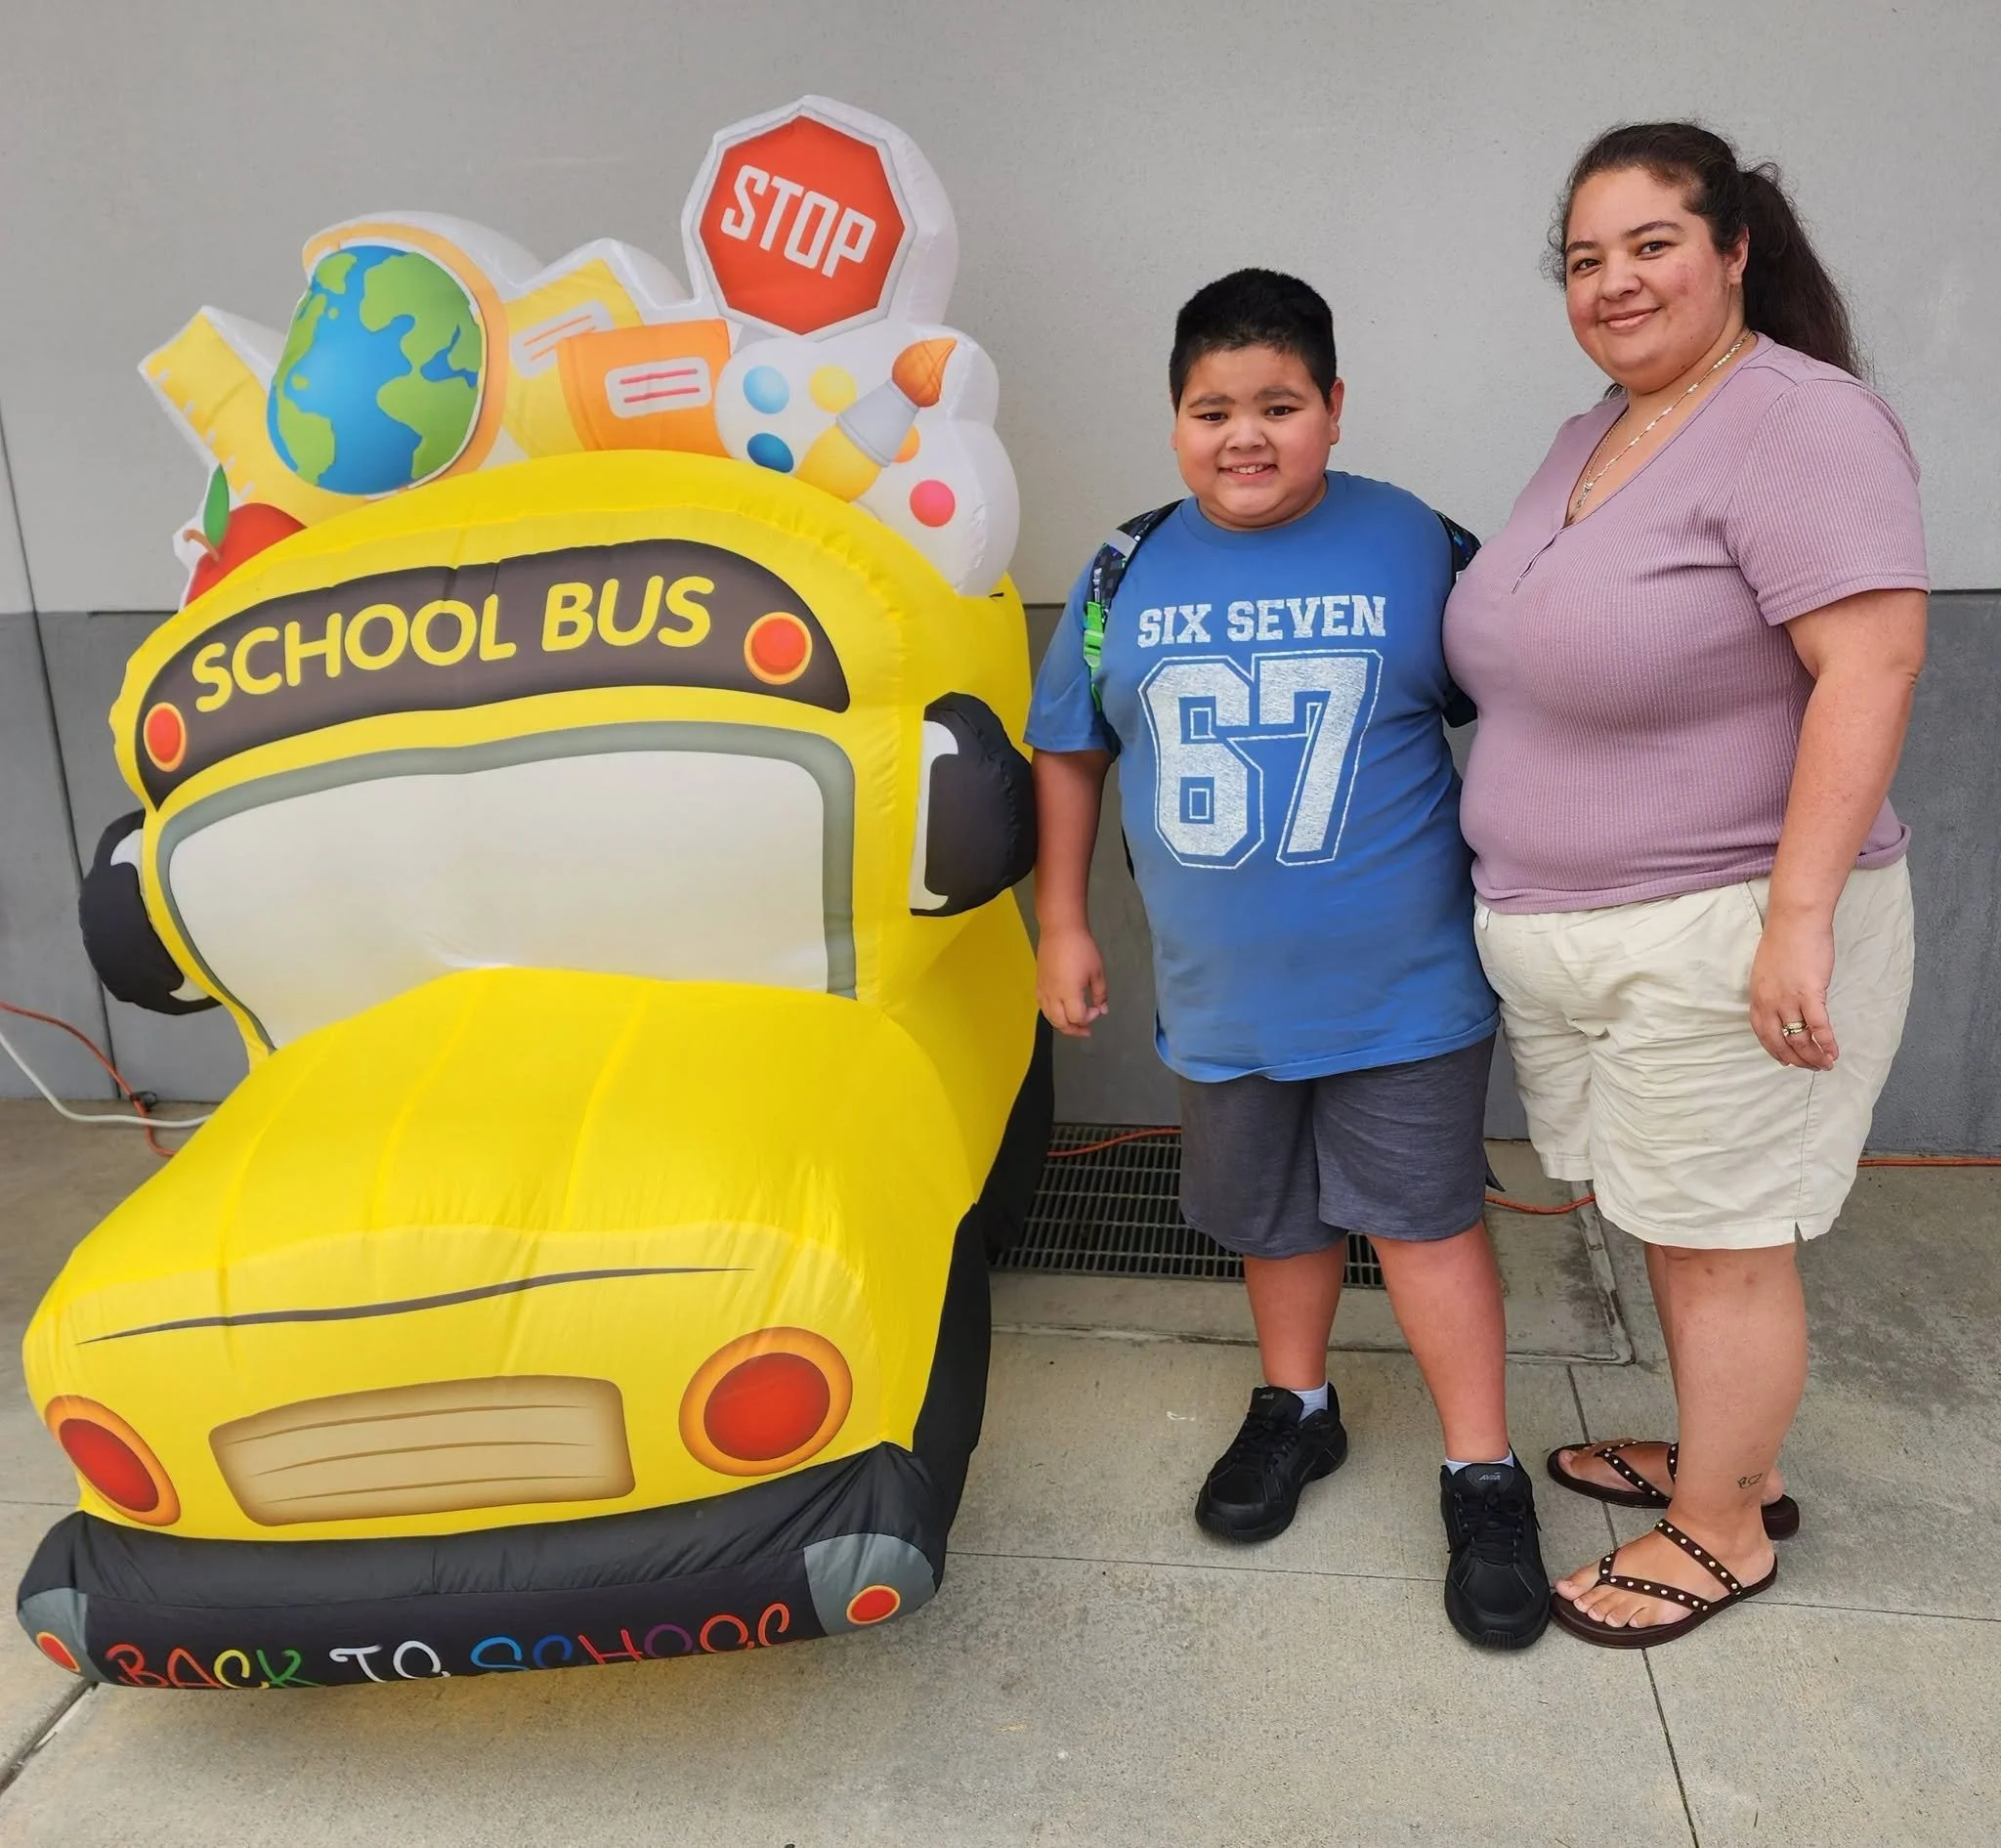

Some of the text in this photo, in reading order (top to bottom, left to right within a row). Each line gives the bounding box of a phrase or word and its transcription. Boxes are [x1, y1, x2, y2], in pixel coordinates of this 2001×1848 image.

[720, 164, 876, 279] STOP
[191, 575, 715, 713] SCHOOL BUS
[1137, 594, 1386, 648] SIX SEVEN
[1137, 648, 1384, 870] 67
[105, 1643, 327, 1689] BACK
[328, 1640, 451, 1683] TO
